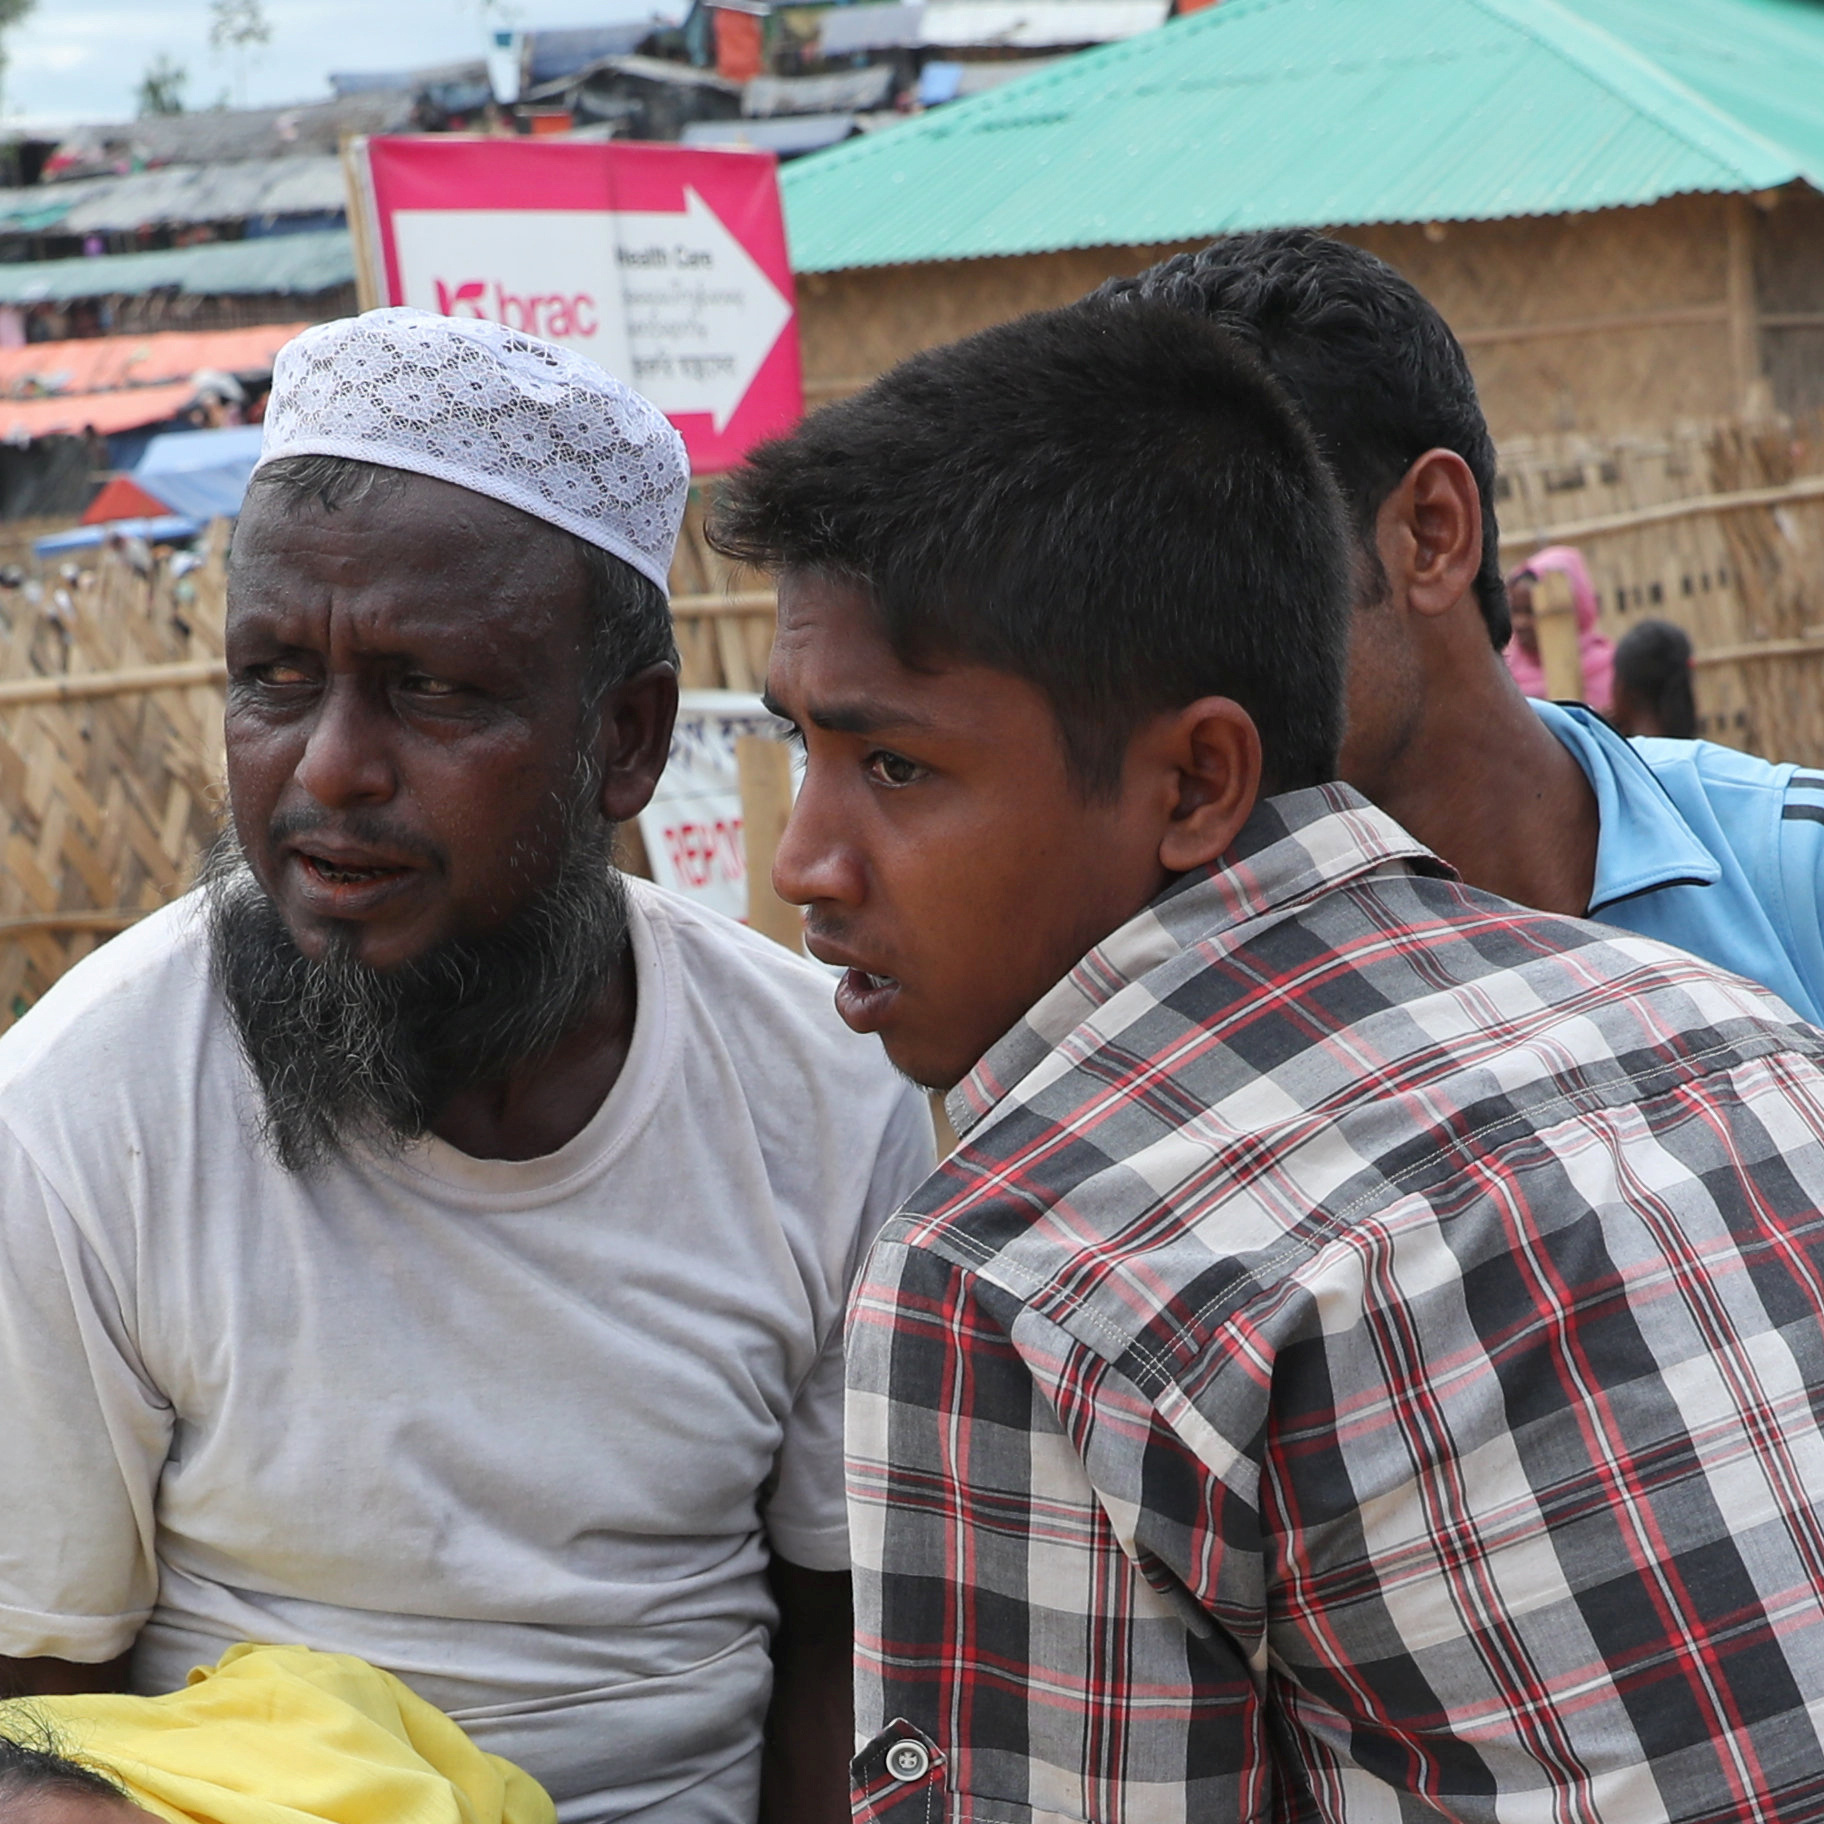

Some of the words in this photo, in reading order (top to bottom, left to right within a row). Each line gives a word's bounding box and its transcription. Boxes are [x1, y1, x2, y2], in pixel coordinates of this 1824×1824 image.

[617, 246, 666, 267] Health
[675, 246, 712, 268] Care
[495, 280, 598, 338] brac
